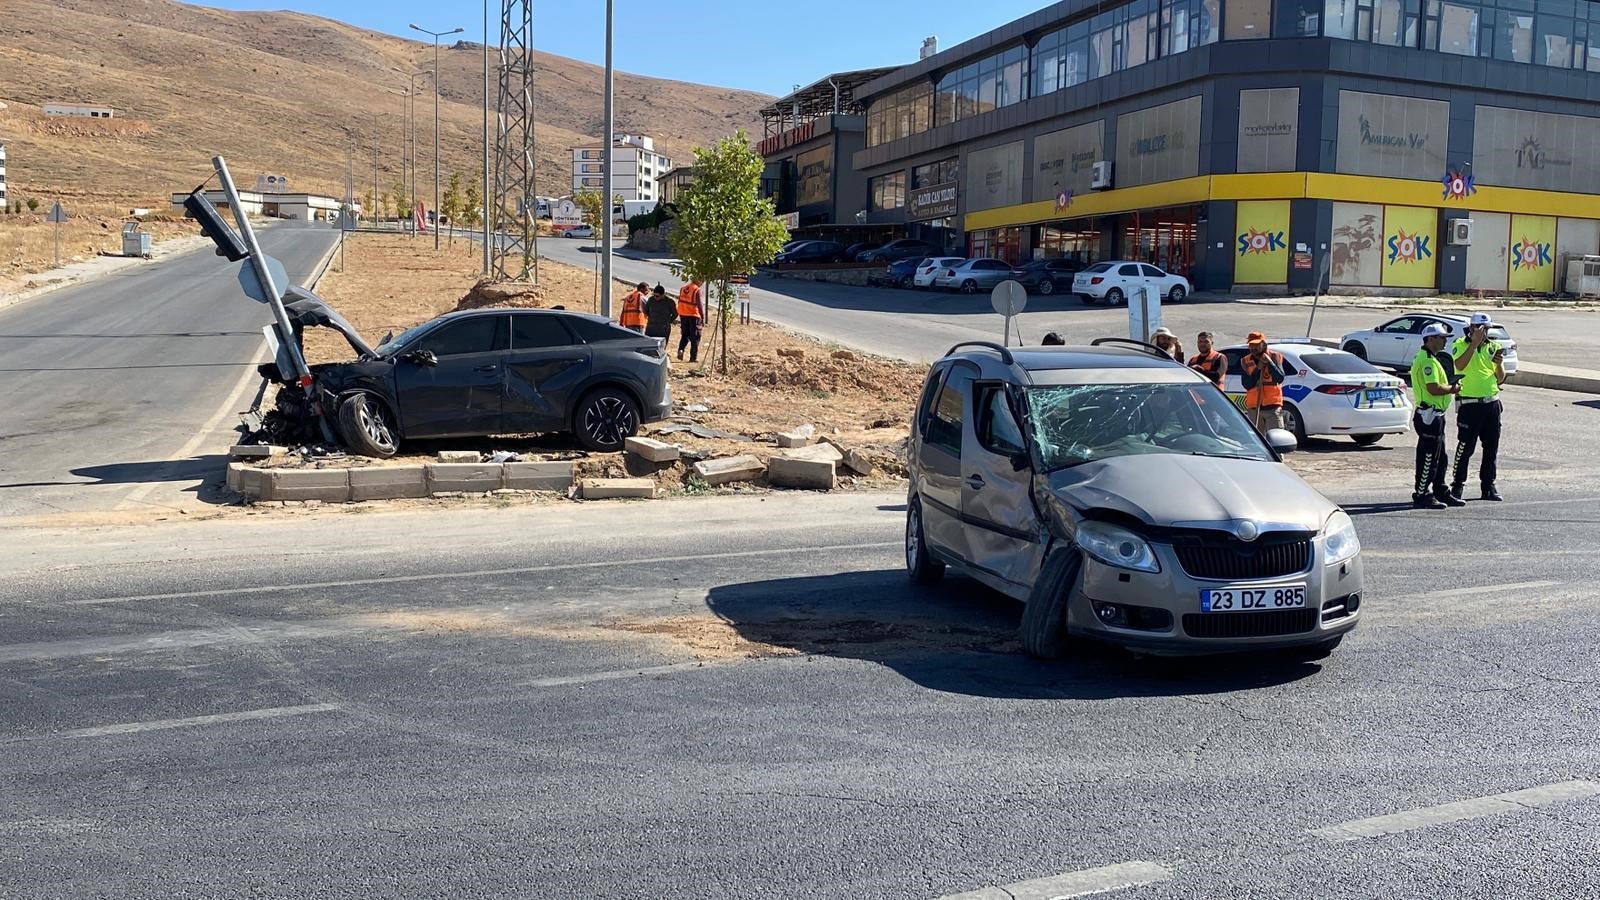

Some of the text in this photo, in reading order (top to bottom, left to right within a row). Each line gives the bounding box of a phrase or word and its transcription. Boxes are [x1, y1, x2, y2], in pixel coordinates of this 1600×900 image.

[1212, 592, 1233, 610] 23
[1241, 590, 1266, 609] DZ
[1274, 588, 1304, 607] 885
